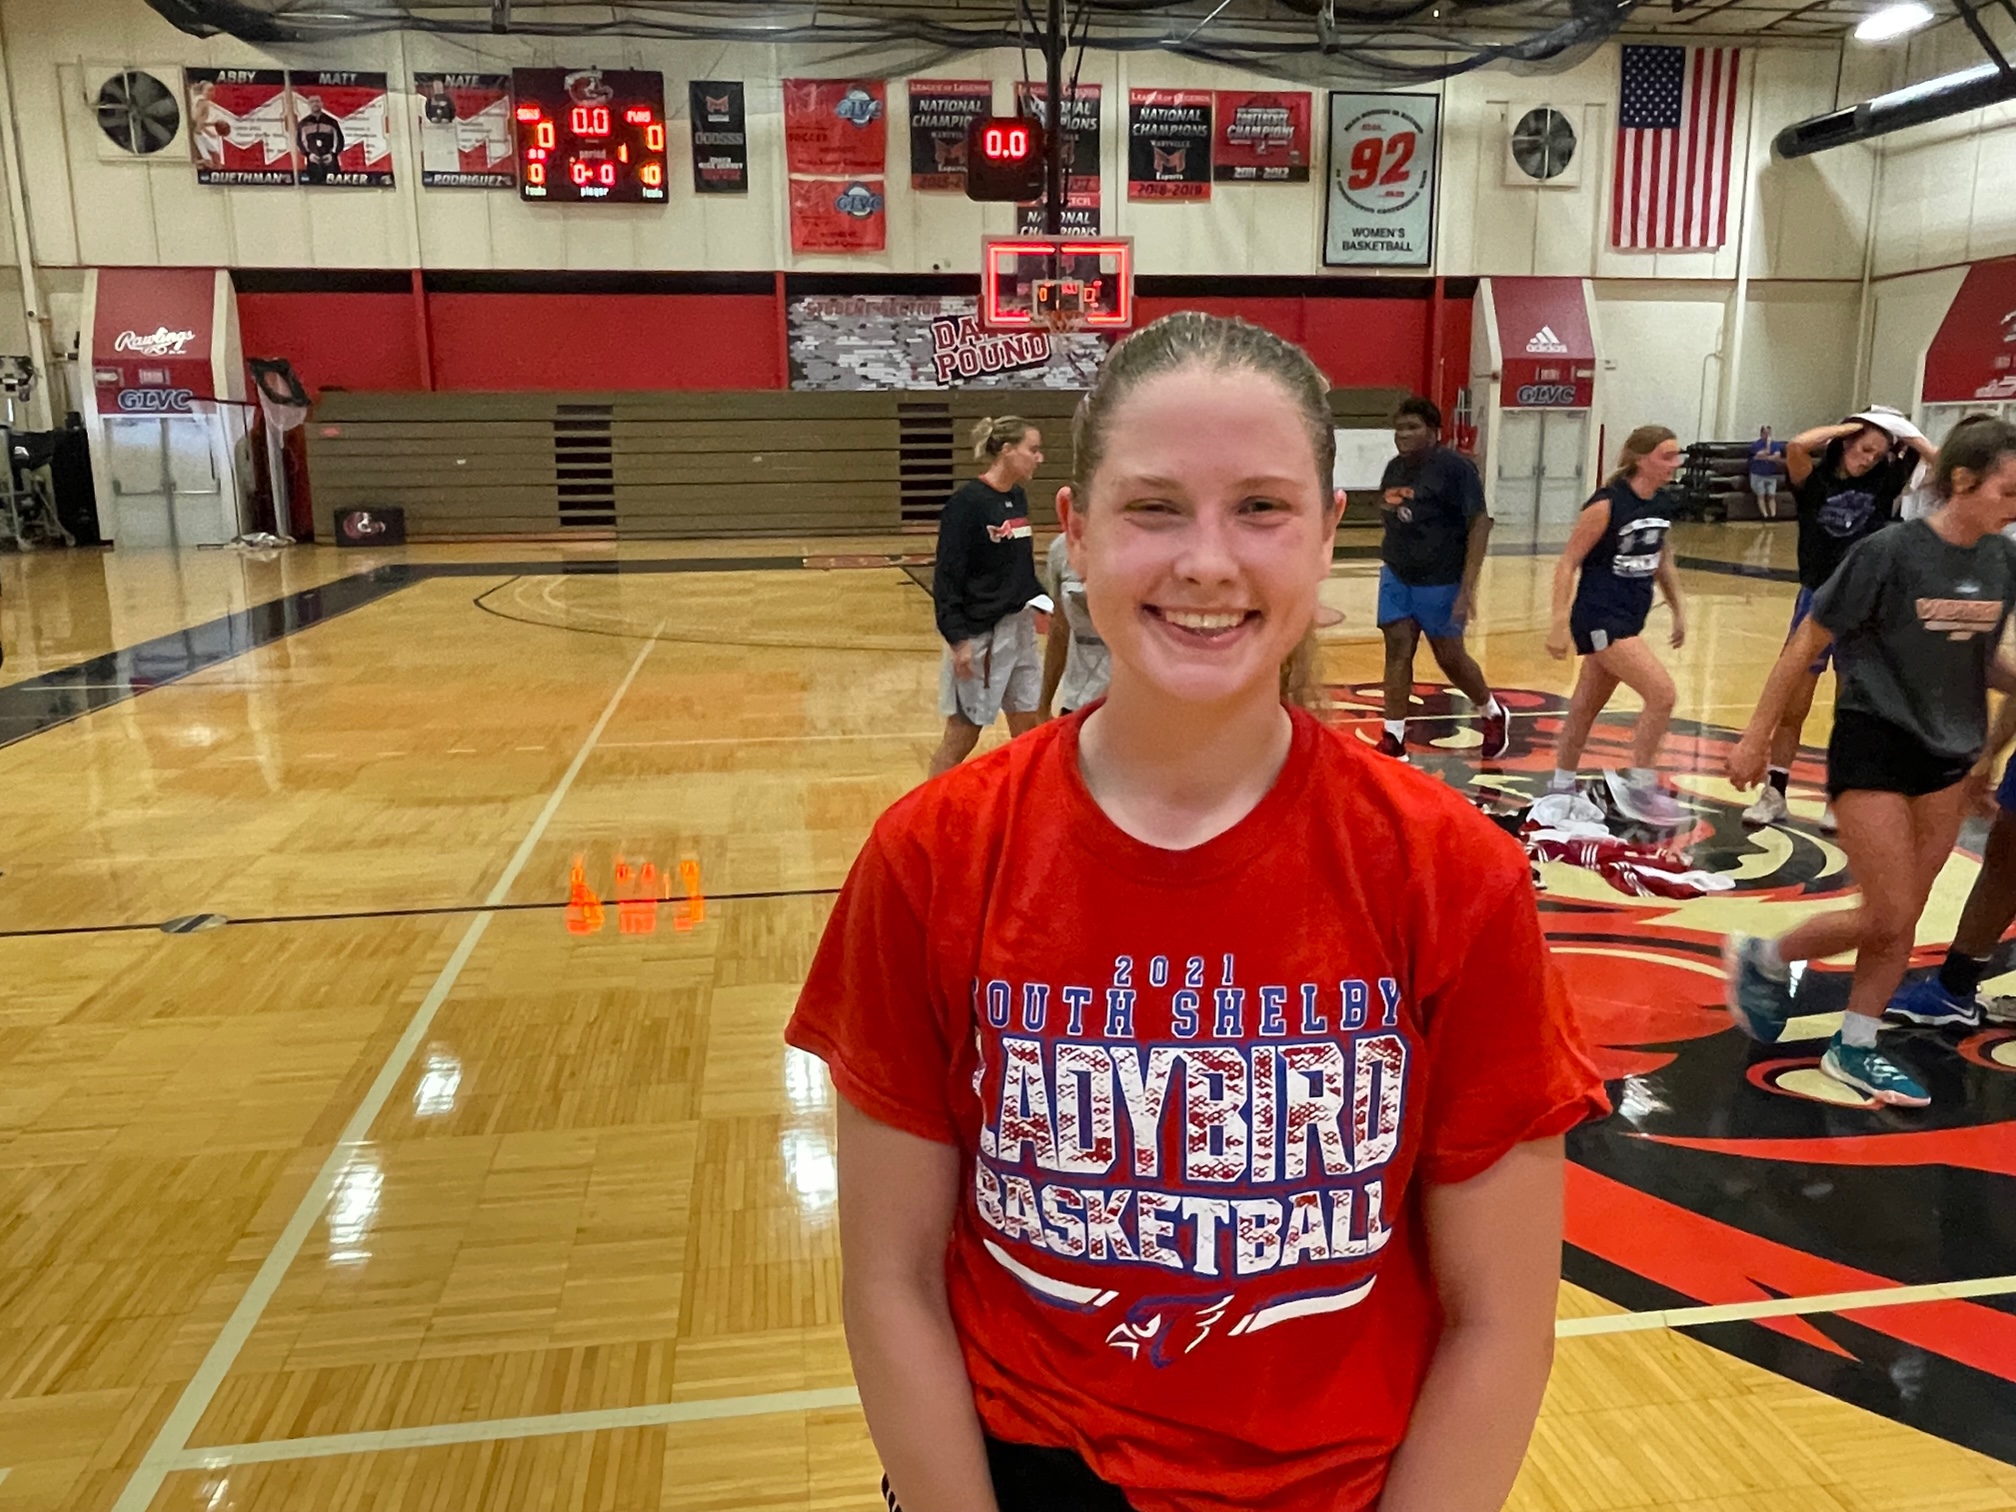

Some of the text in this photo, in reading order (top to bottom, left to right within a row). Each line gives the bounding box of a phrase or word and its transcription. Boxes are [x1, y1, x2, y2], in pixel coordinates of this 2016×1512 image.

[216, 70, 256, 83] ABBY
[319, 72, 357, 84] MATT
[444, 75, 479, 87] NATE
[918, 99, 983, 113] NATIONAL
[1140, 108, 1202, 121] NATIONAL
[536, 121, 555, 149] 0
[647, 124, 664, 151] 0
[1131, 123, 1208, 137] CHAMPIONS
[1226, 125, 1295, 139] CHAMPIONS
[985, 129, 1027, 158] 0.0
[1347, 131, 1416, 191] 92
[326, 173, 369, 185] BAKER
[433, 174, 502, 186] RODRIGUEZ
[1352, 227, 1405, 238] WOMEN'S
[1342, 241, 1413, 252] BASKETBALL
[114, 326, 196, 353] Rawlings
[933, 331, 1050, 382] POUND
[117, 388, 193, 411] GLVC
[1517, 384, 1576, 404] GLVC
[1114, 953, 1235, 988] 2021
[975, 978, 1402, 1038] OUTH SHELBY
[975, 1155, 1394, 1276] BASKETBALL
